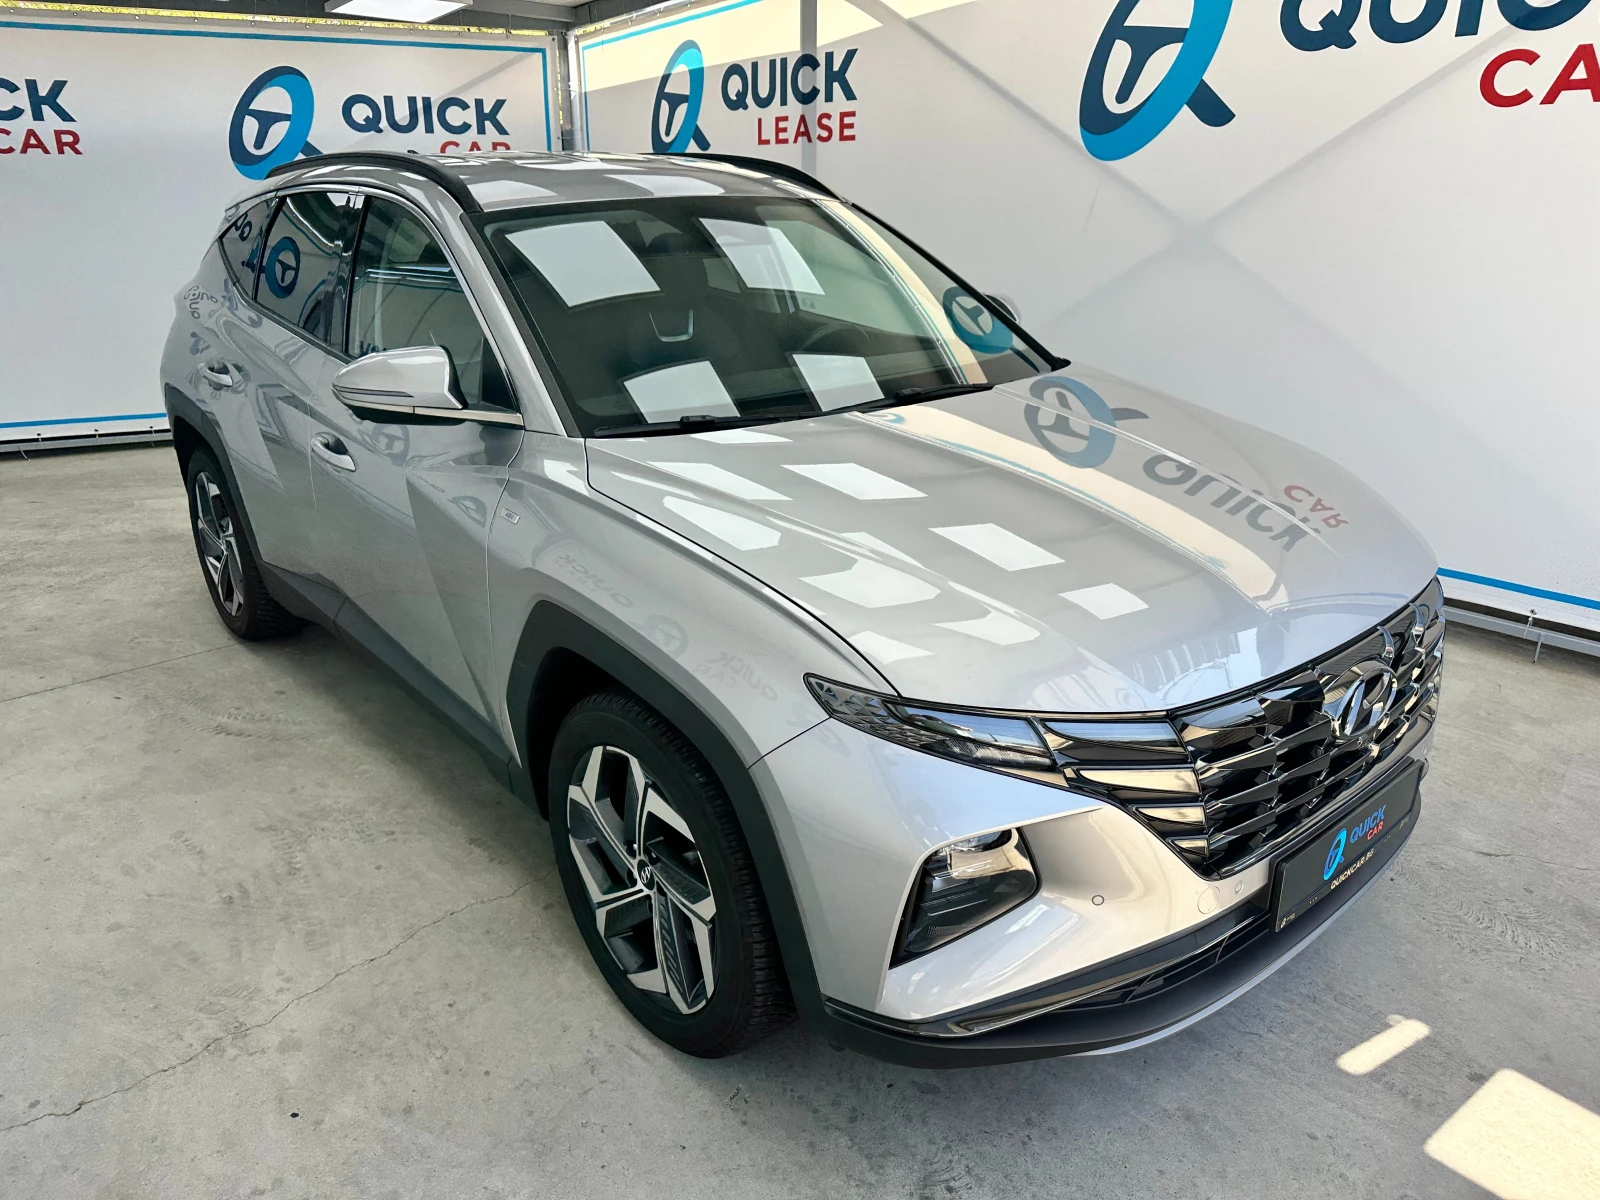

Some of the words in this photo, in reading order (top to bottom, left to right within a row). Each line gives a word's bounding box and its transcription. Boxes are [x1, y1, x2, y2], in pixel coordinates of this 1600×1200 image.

[721, 48, 859, 112] QUICK
[341, 93, 511, 136] QUICK
[757, 110, 857, 146] LEASE
[0, 127, 83, 155] CAR
[1349, 803, 1387, 844] QUICK
[1367, 820, 1384, 841] CAR
